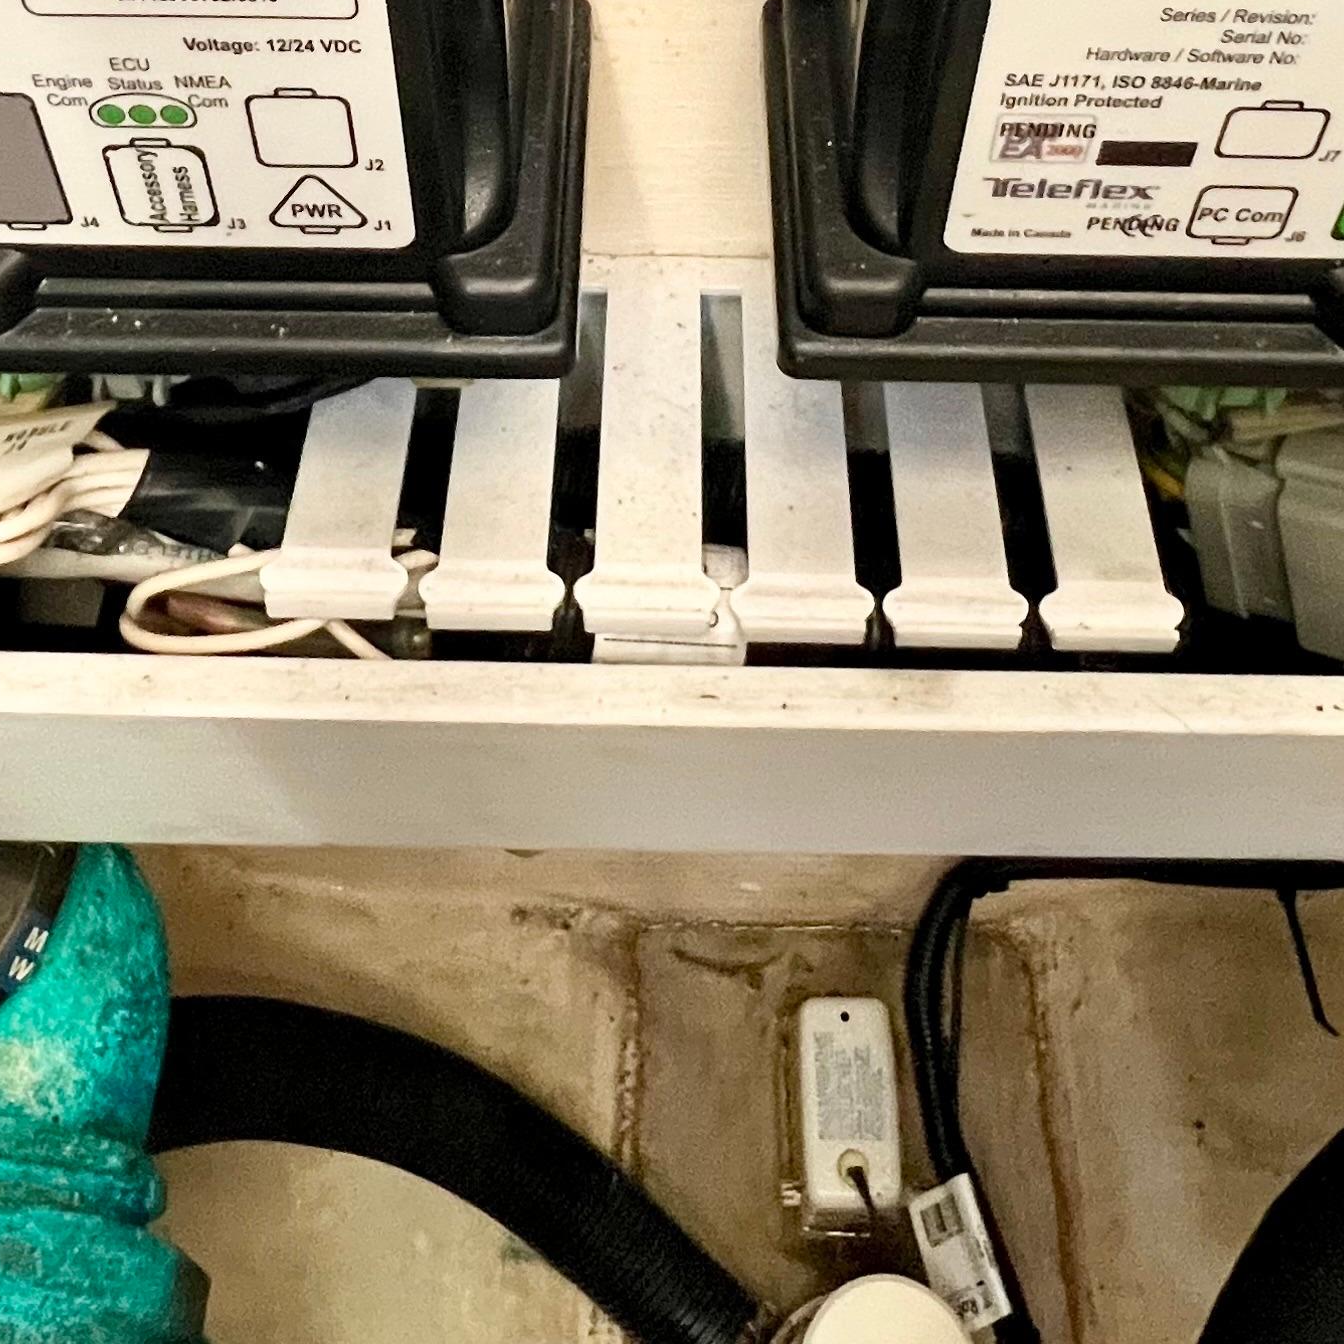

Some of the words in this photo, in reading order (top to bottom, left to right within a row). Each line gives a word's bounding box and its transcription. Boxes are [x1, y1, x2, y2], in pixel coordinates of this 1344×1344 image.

[1160, 8, 1216, 23] Series
[1232, 9, 1316, 25] Revision:
[1220, 30, 1271, 44] Serial
[1276, 31, 1309, 46] No:
[183, 38, 260, 55] Voltage:
[266, 38, 315, 53] 12/24
[320, 39, 362, 54] VDC
[1086, 47, 1171, 62] Hardware
[1187, 48, 1264, 64] Software
[1268, 51, 1299, 65] No:
[109, 57, 151, 72] ECU
[32, 74, 94, 90] Engine
[108, 76, 163, 92] Status
[174, 76, 232, 89] NMEA
[1004, 73, 1044, 88] SAE
[1049, 74, 1107, 91] J1171,
[1111, 75, 1147, 90] ISO
[1150, 76, 1262, 92] 8846-Marine
[47, 93, 90, 108] Com
[188, 94, 229, 109] Com
[999, 93, 1070, 110] Ignition
[1073, 94, 1163, 109] Protected
[1000, 122, 1097, 139] PENDING
[1318, 149, 1342, 163] J7
[365, 158, 385, 172] J2
[135, 147, 168, 222] Accessory
[982, 177, 1156, 201] Teleflex
[173, 165, 201, 222] Harness
[291, 203, 343, 219] PWR
[1197, 206, 1229, 223] PC
[1235, 207, 1286, 224] Com
[81, 215, 100, 229] J4
[227, 216, 247, 230] J3
[374, 218, 392, 232] J1
